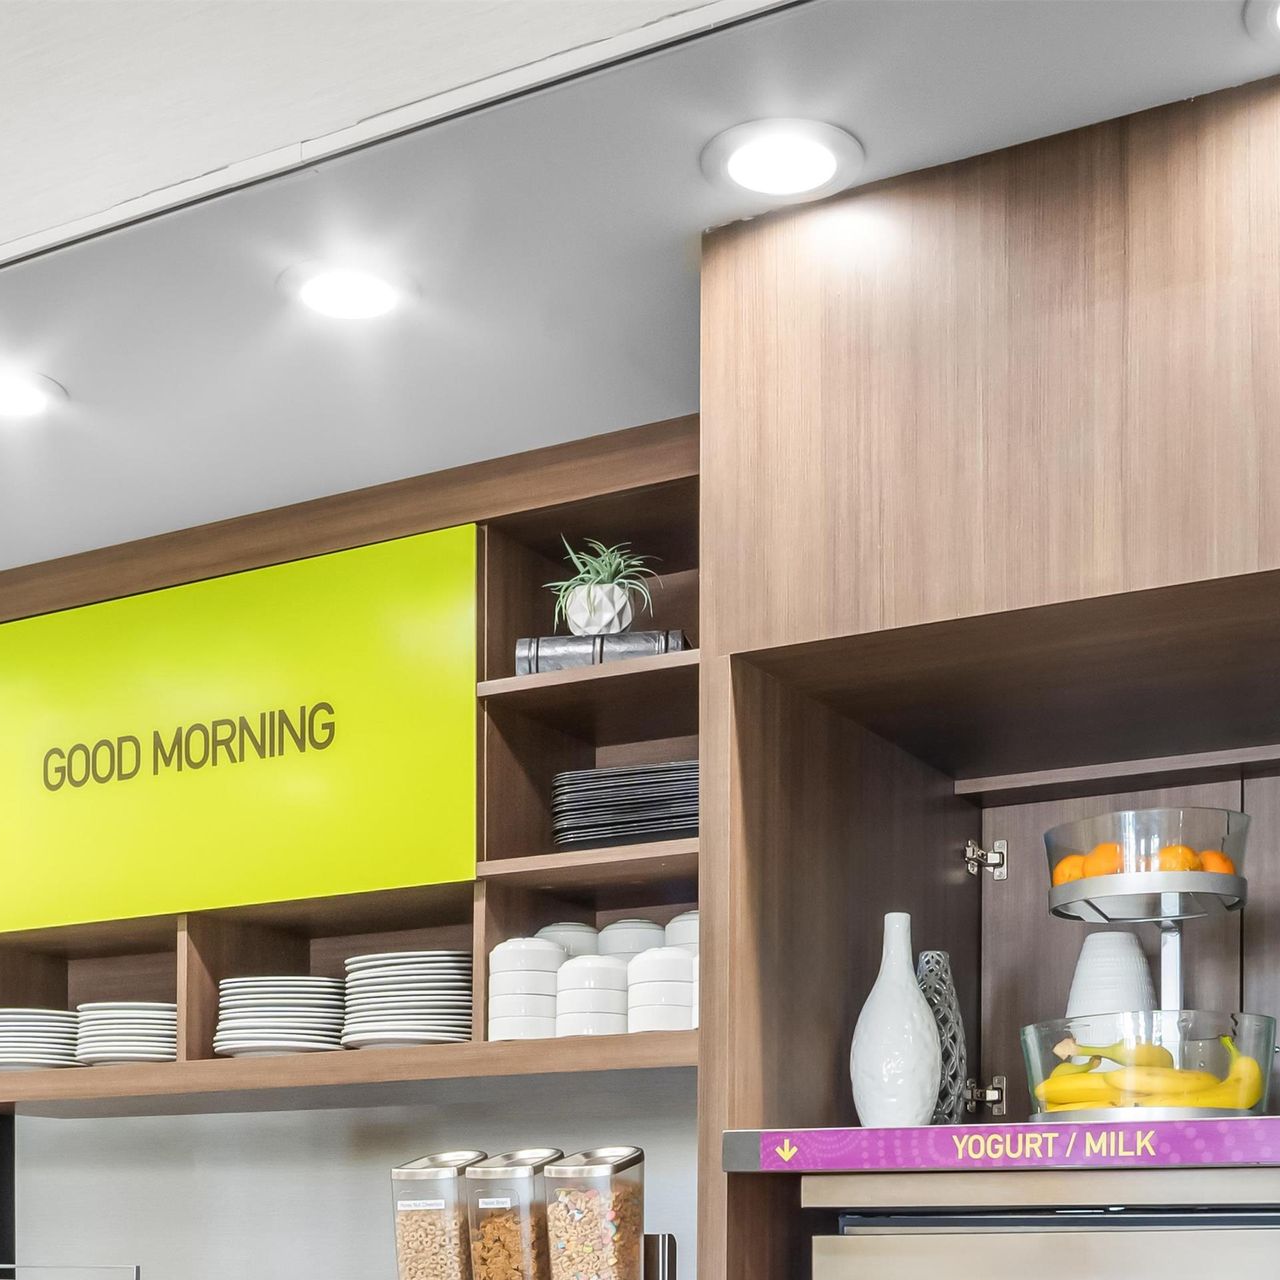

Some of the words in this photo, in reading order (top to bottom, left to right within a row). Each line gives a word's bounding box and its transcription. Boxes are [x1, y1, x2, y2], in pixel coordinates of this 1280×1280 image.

[43, 735, 141, 792] GOOD
[153, 701, 336, 776] MORNING
[952, 1132, 1059, 1160] YOGURT
[1065, 1132, 1077, 1158] /
[1085, 1130, 1156, 1157] MILK
